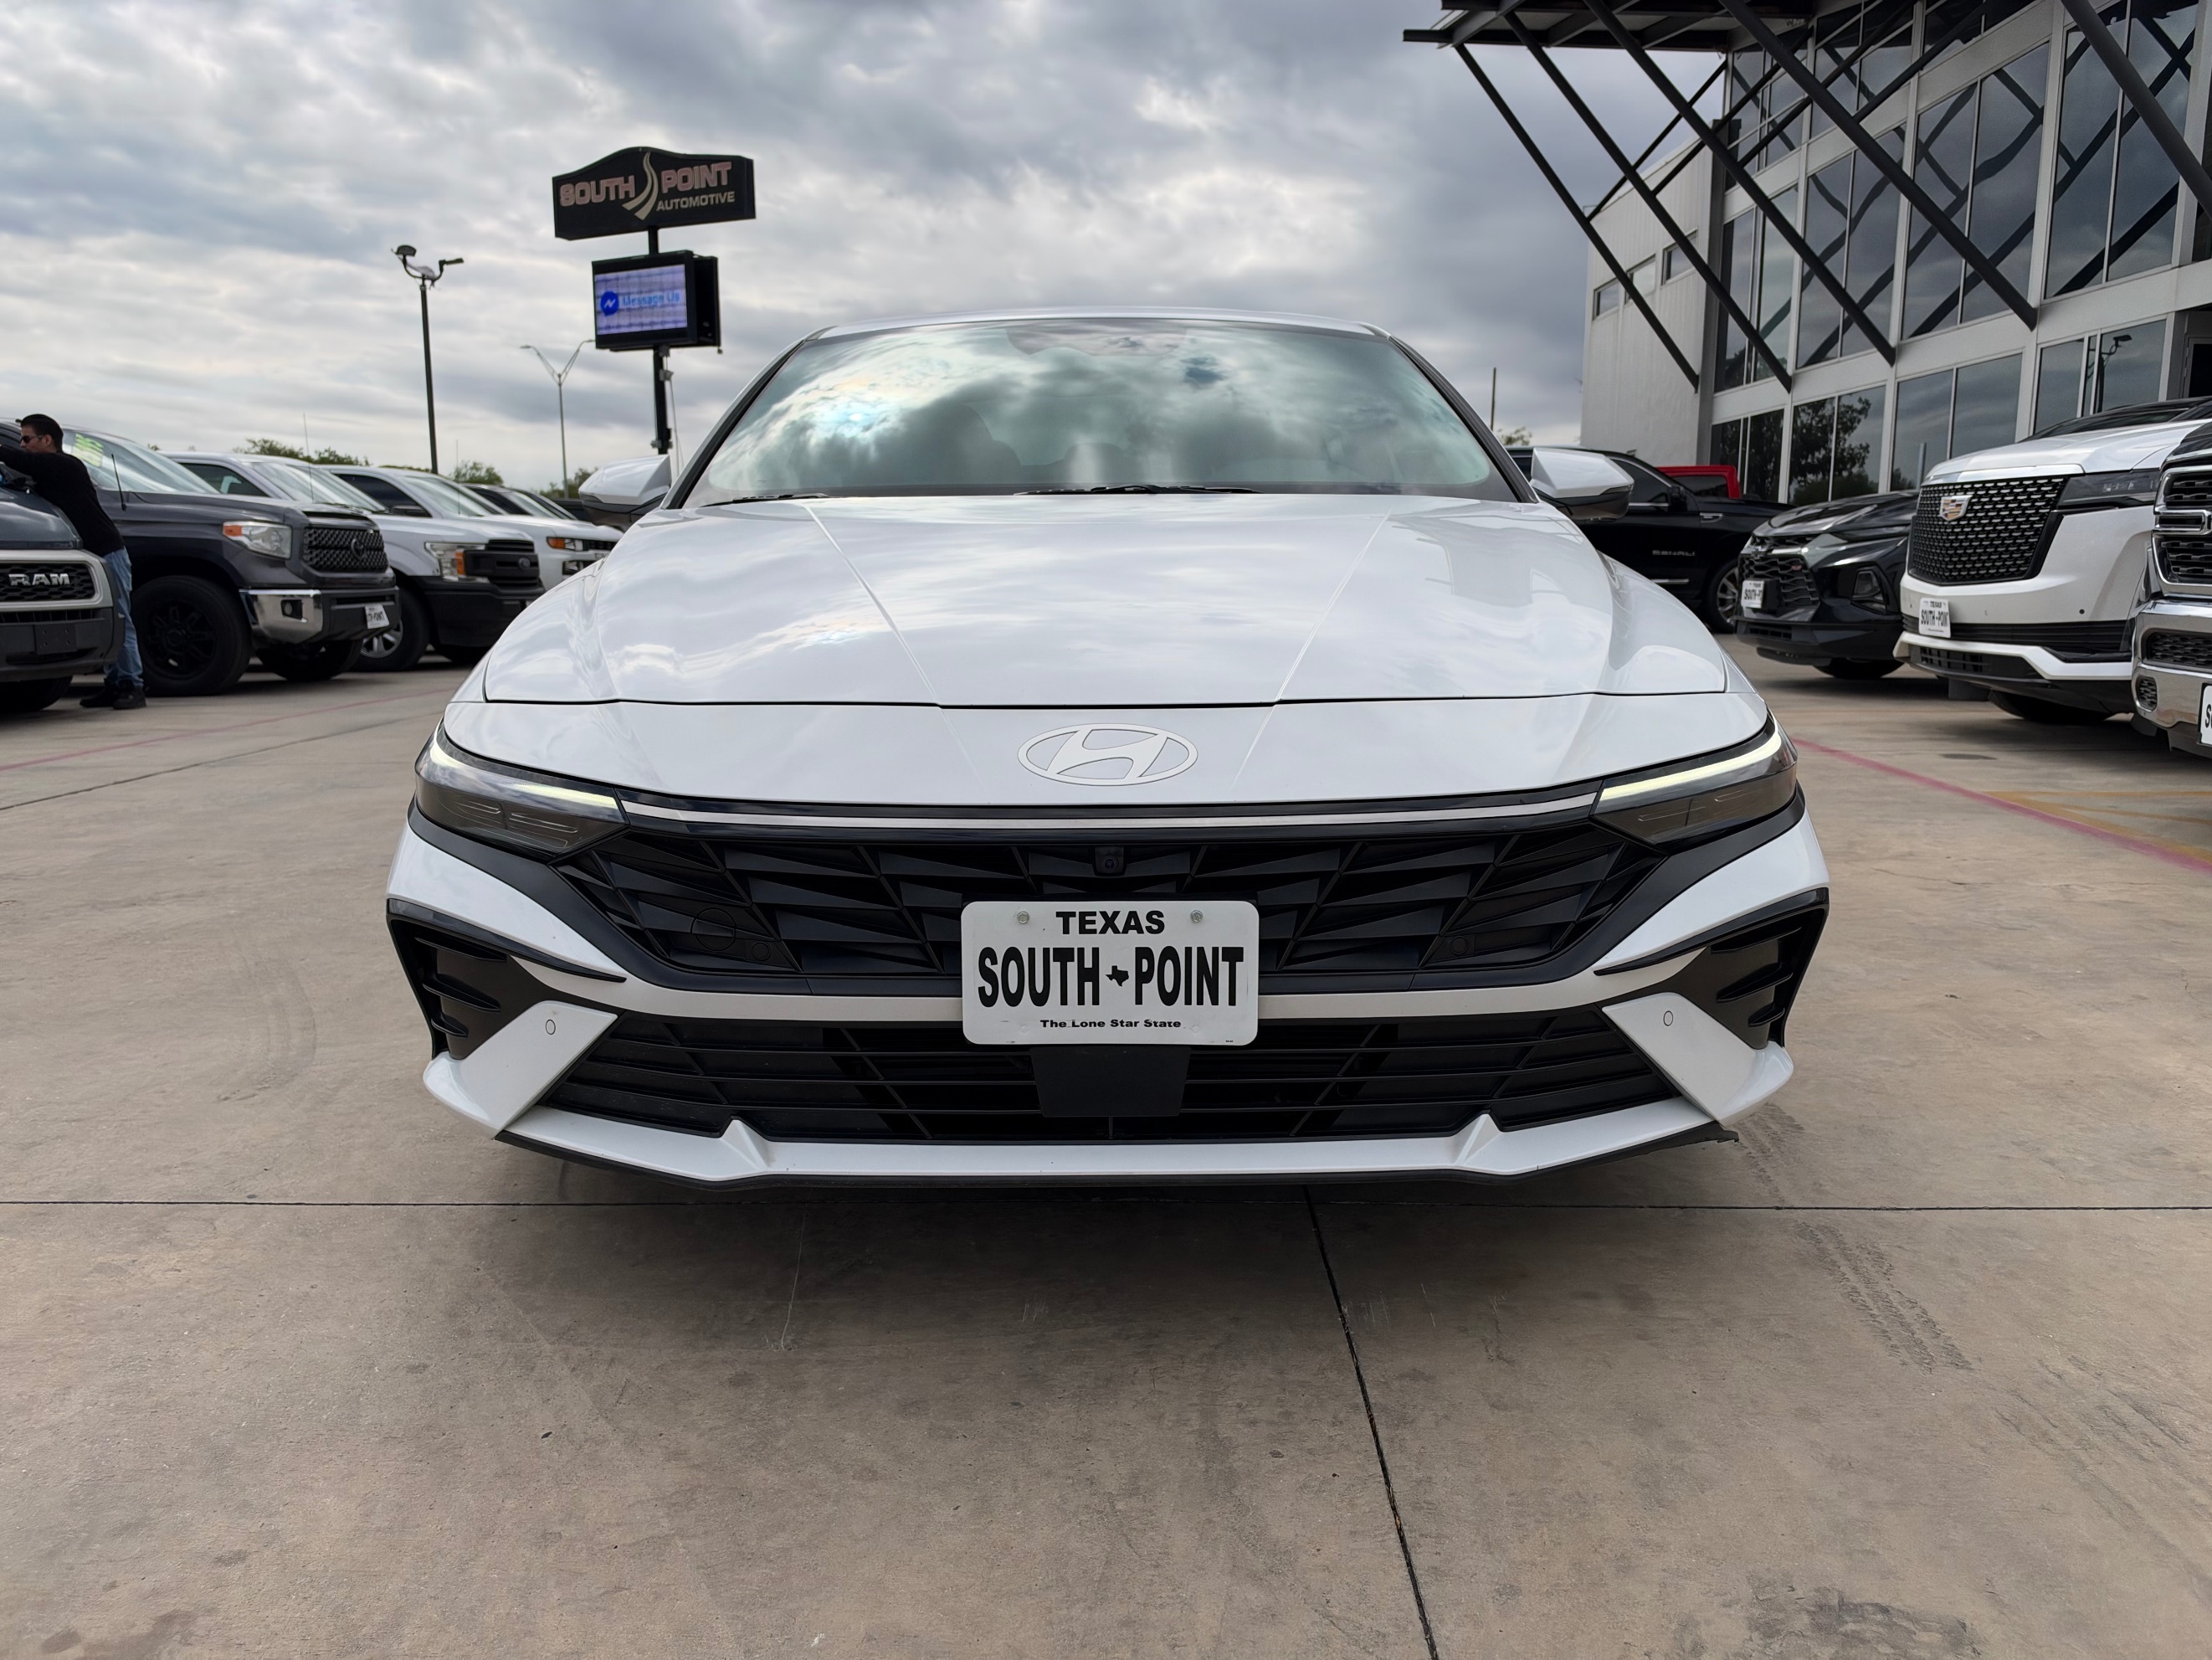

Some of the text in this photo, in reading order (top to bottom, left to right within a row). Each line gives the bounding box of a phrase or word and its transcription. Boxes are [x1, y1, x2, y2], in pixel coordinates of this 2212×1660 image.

[560, 162, 732, 206] SOUTH POINT
[656, 191, 735, 211] AUTOMOTIVE
[8, 573, 70, 586] RAM
[1056, 911, 1164, 934] TEXAS
[978, 946, 1244, 1007] SOUTH POINT
